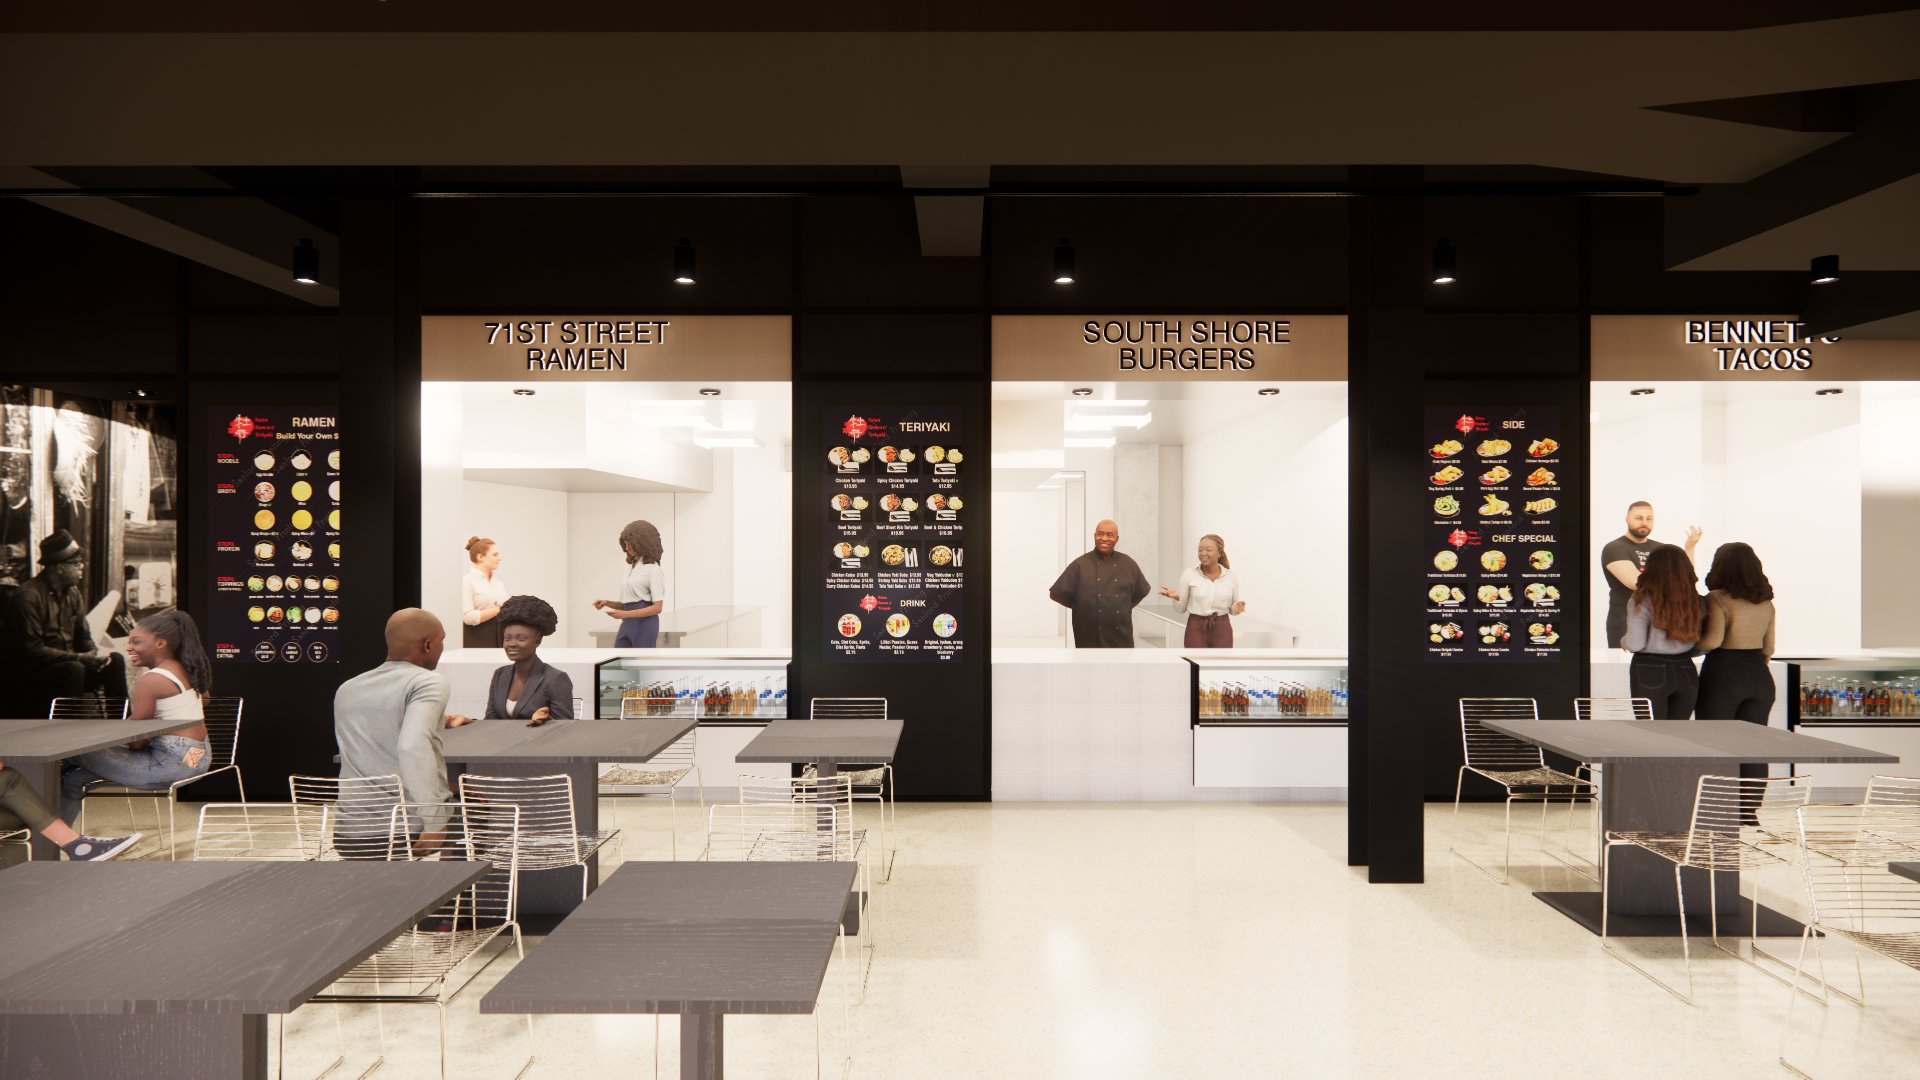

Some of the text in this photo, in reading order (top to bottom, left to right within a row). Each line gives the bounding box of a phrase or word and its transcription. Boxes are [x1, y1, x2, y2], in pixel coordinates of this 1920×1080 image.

[484, 321, 670, 345] 71ST STREET
[1083, 321, 1290, 344] SOUTH SHORE
[526, 348, 628, 371] RAMEN
[1119, 348, 1256, 370] BURGERS
[1713, 348, 1813, 371] TACOS
[292, 417, 336, 428] RAMEN
[898, 422, 950, 432] TERIYAKI
[1502, 420, 1526, 429] SIDE
